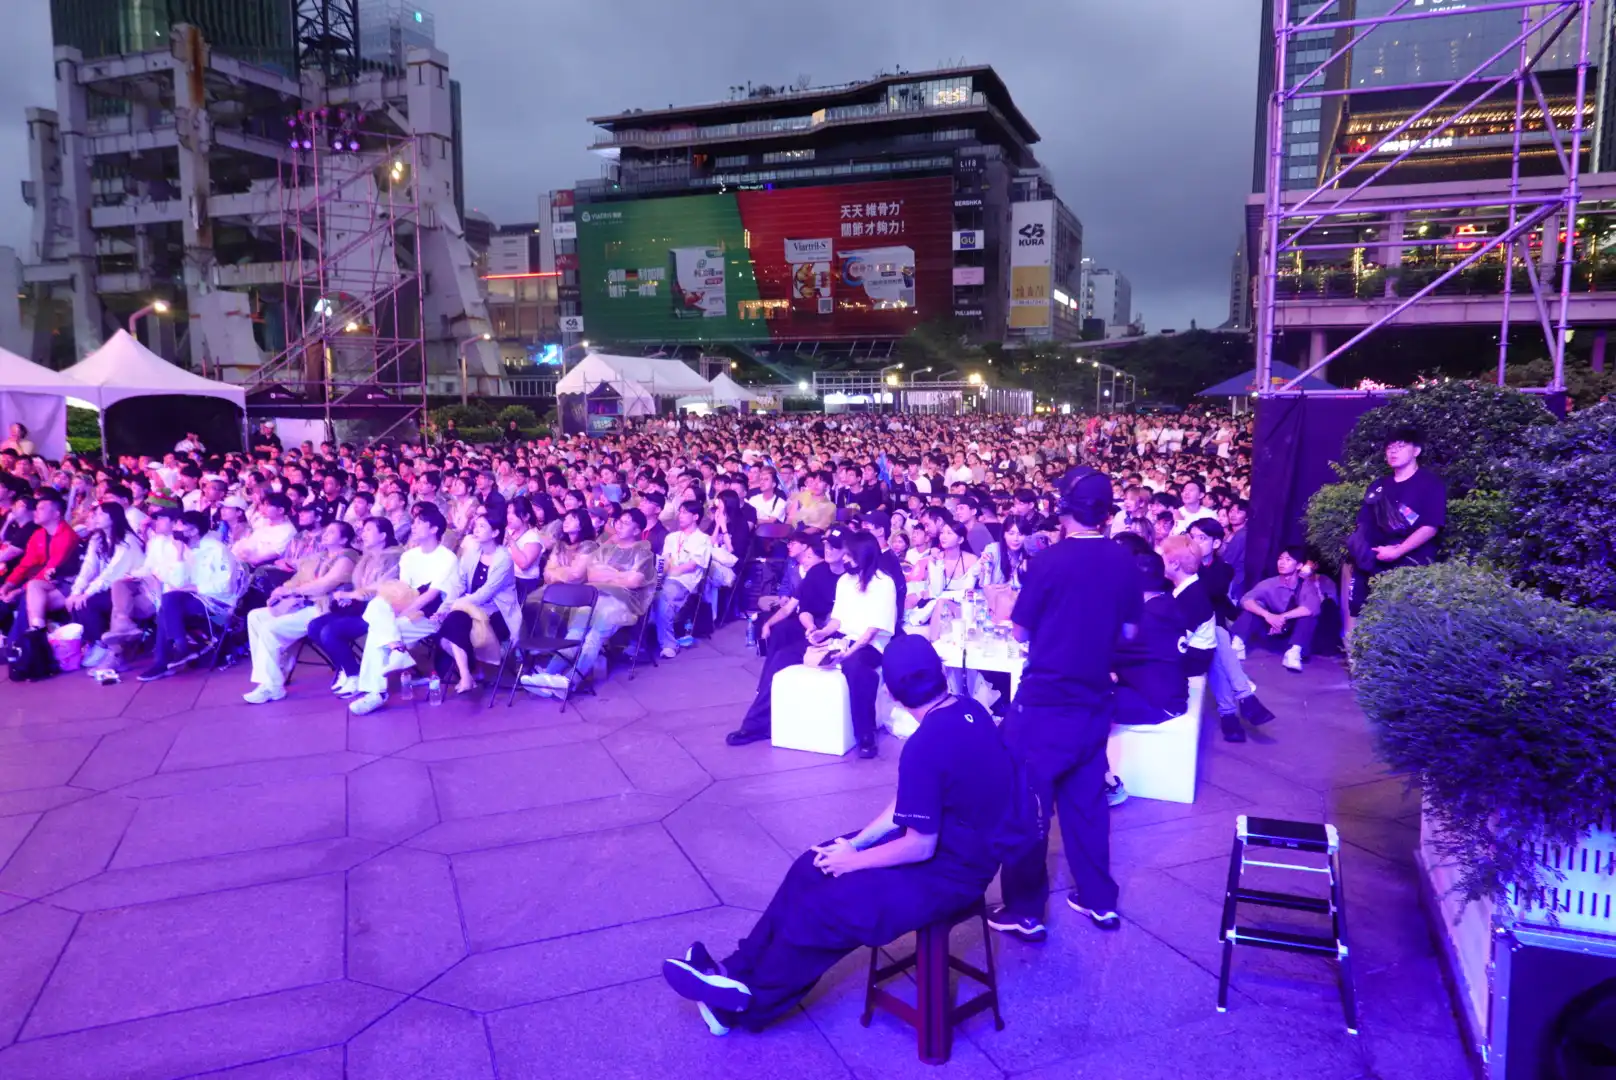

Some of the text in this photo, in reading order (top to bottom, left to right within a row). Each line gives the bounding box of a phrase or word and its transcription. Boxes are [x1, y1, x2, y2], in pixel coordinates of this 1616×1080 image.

[954, 199, 982, 207] BERSHKA
[840, 203, 864, 219] 天天
[1018, 223, 1046, 239] くら
[793, 239, 827, 252] Viartril-S
[960, 236, 975, 244] GU
[1018, 238, 1045, 247] KURA
